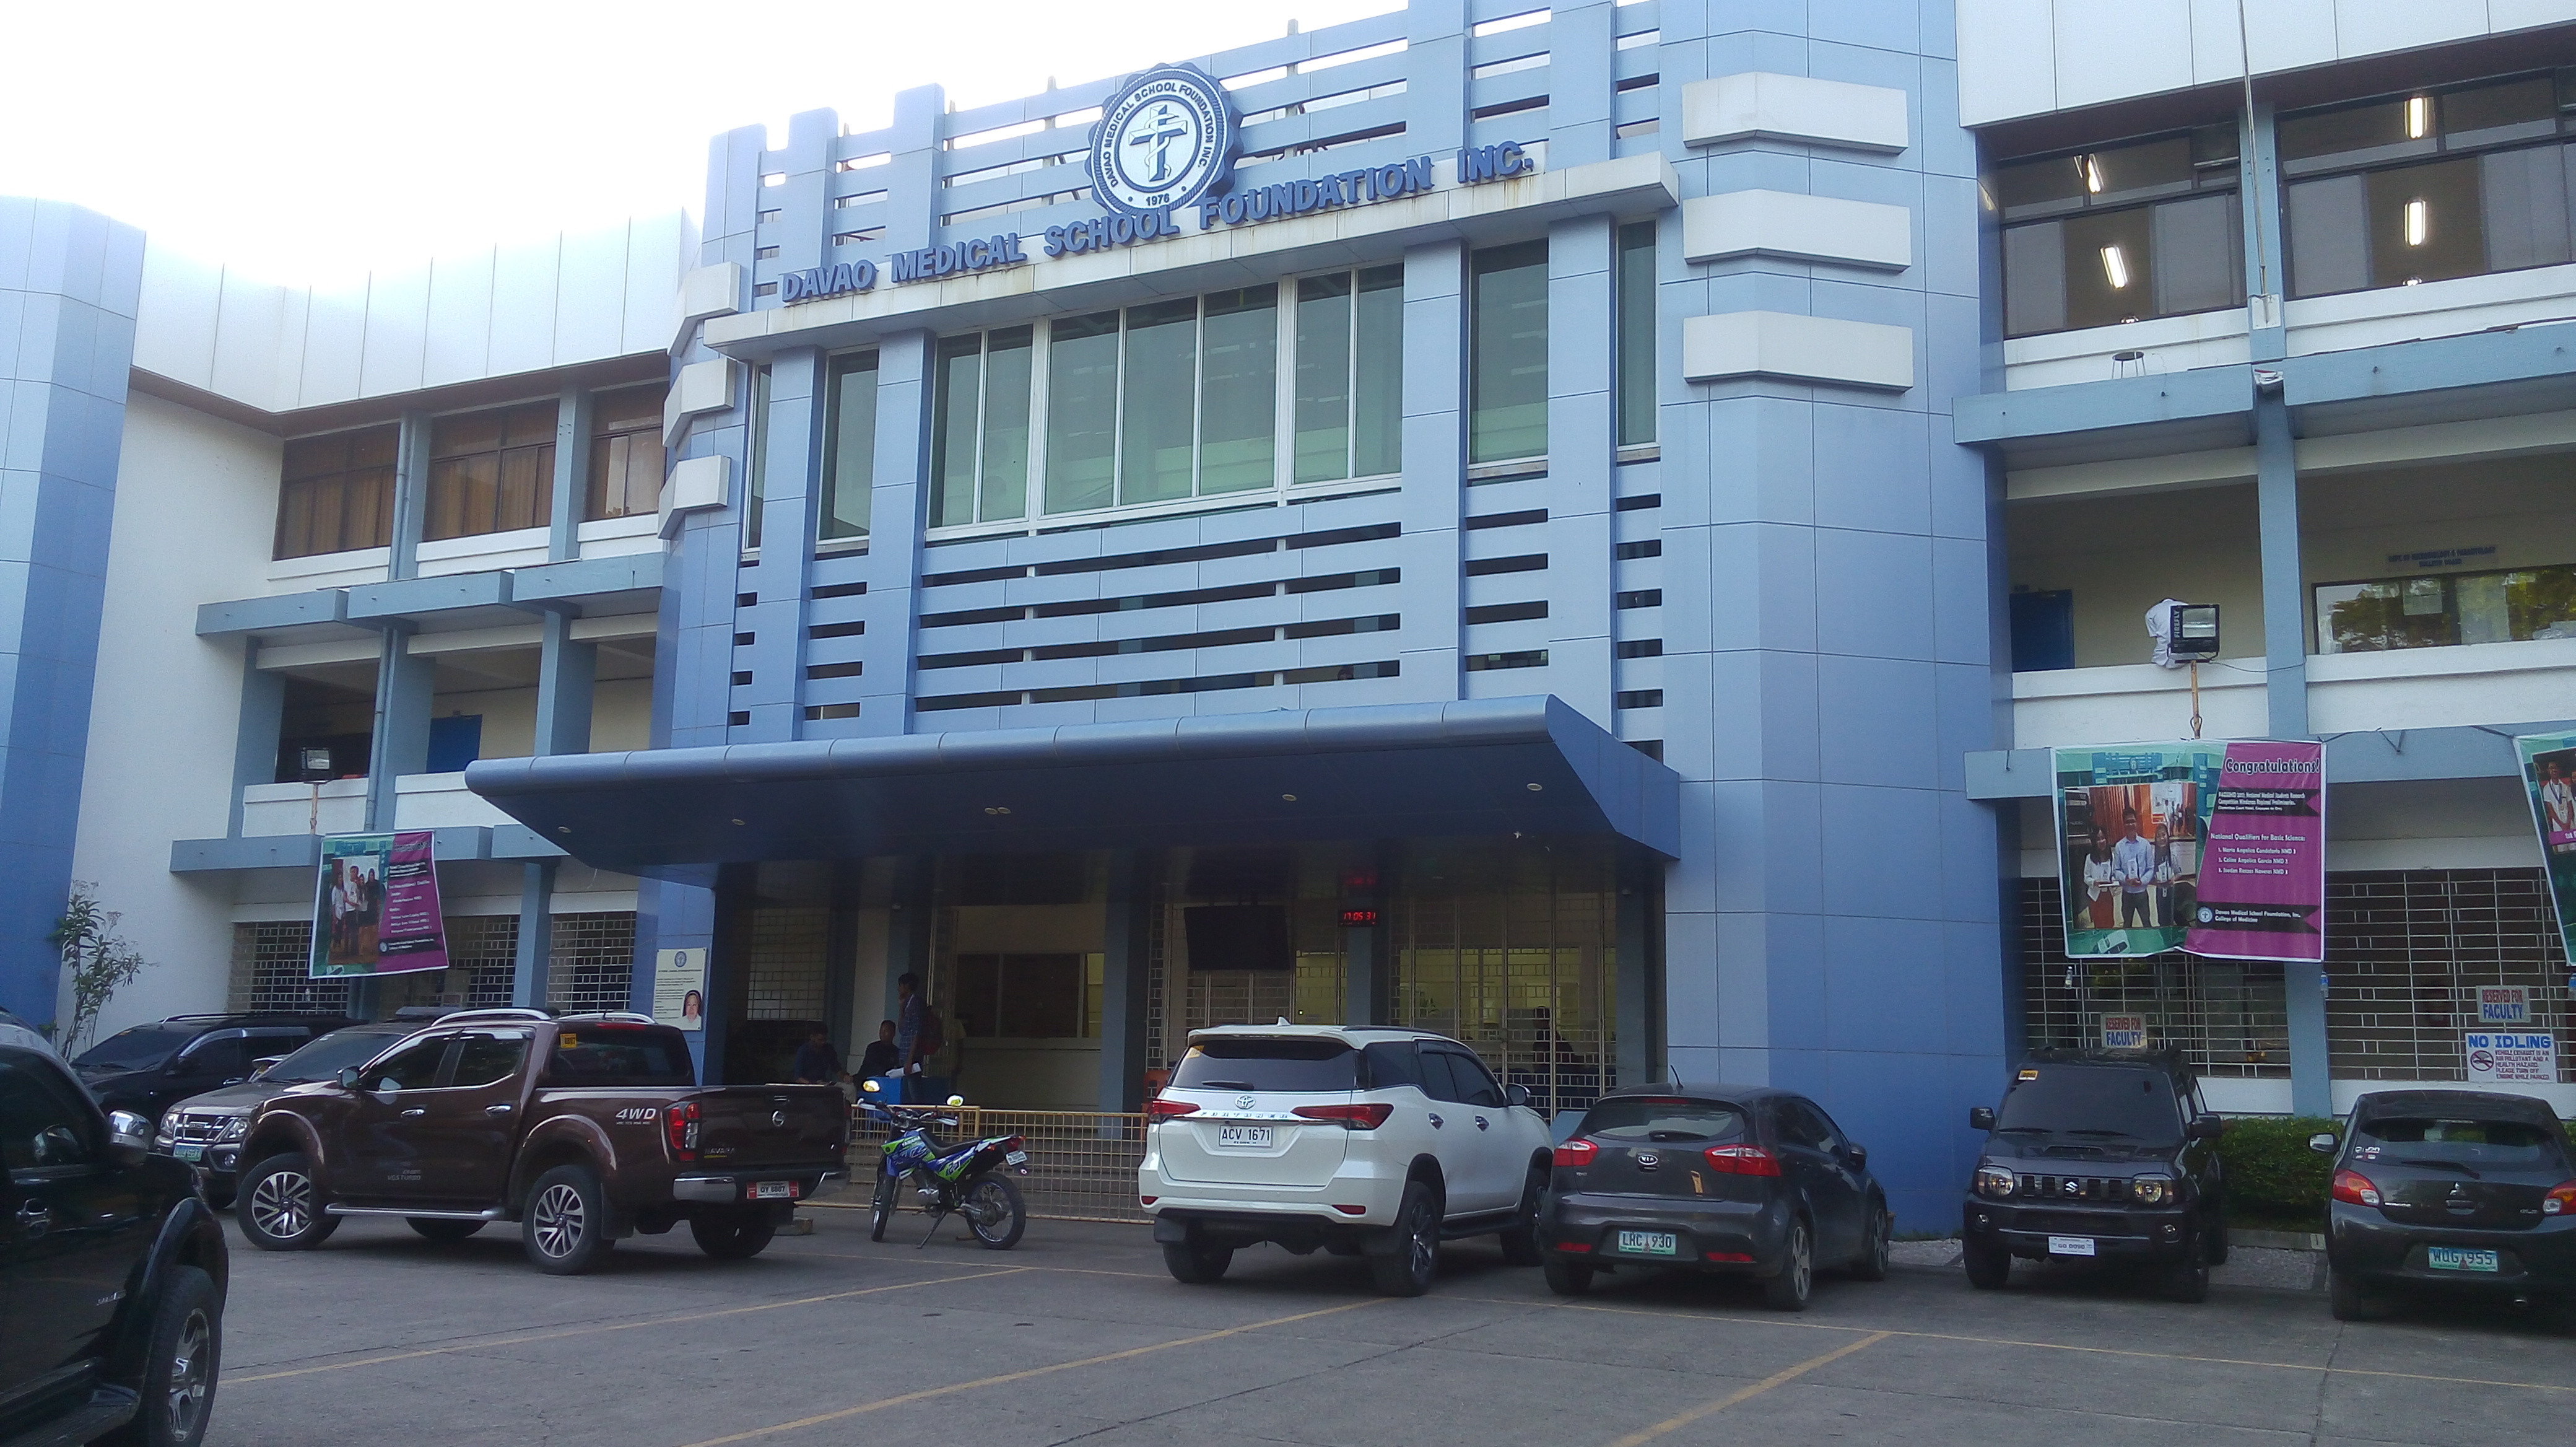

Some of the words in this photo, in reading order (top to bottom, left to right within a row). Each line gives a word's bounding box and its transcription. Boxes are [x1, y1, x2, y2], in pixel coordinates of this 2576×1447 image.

[1135, 82, 1177, 102] SCHOOL
[1179, 84, 1214, 144] FOUNDATION
[1103, 102, 1134, 147] MEDICAL
[1198, 147, 1212, 168] INC.
[1103, 151, 1118, 188] DAVAO
[782, 258, 877, 302] DAVAO
[892, 233, 1027, 282] MEDICAL
[1043, 204, 1180, 257] SCHOOL
[1199, 155, 1434, 230] FOUNDATION
[1457, 141, 1534, 183] INC.
[2225, 757, 2320, 776] Congratulations!
[2482, 989, 2510, 1003] RESERVED
[2511, 989, 2523, 1003] FOR
[2483, 1003, 2523, 1019] FACULTY
[2107, 1031, 2141, 1046] FACULTY
[2468, 1035, 2489, 1048] NO
[2494, 1036, 2551, 1049] IDLING
[616, 1108, 656, 1119] 4WD
[1222, 1128, 1242, 1140] ACV
[1248, 1129, 1269, 1141] 1671
[1651, 1236, 1672, 1248] 930
[2467, 1252, 2492, 1265] 955
